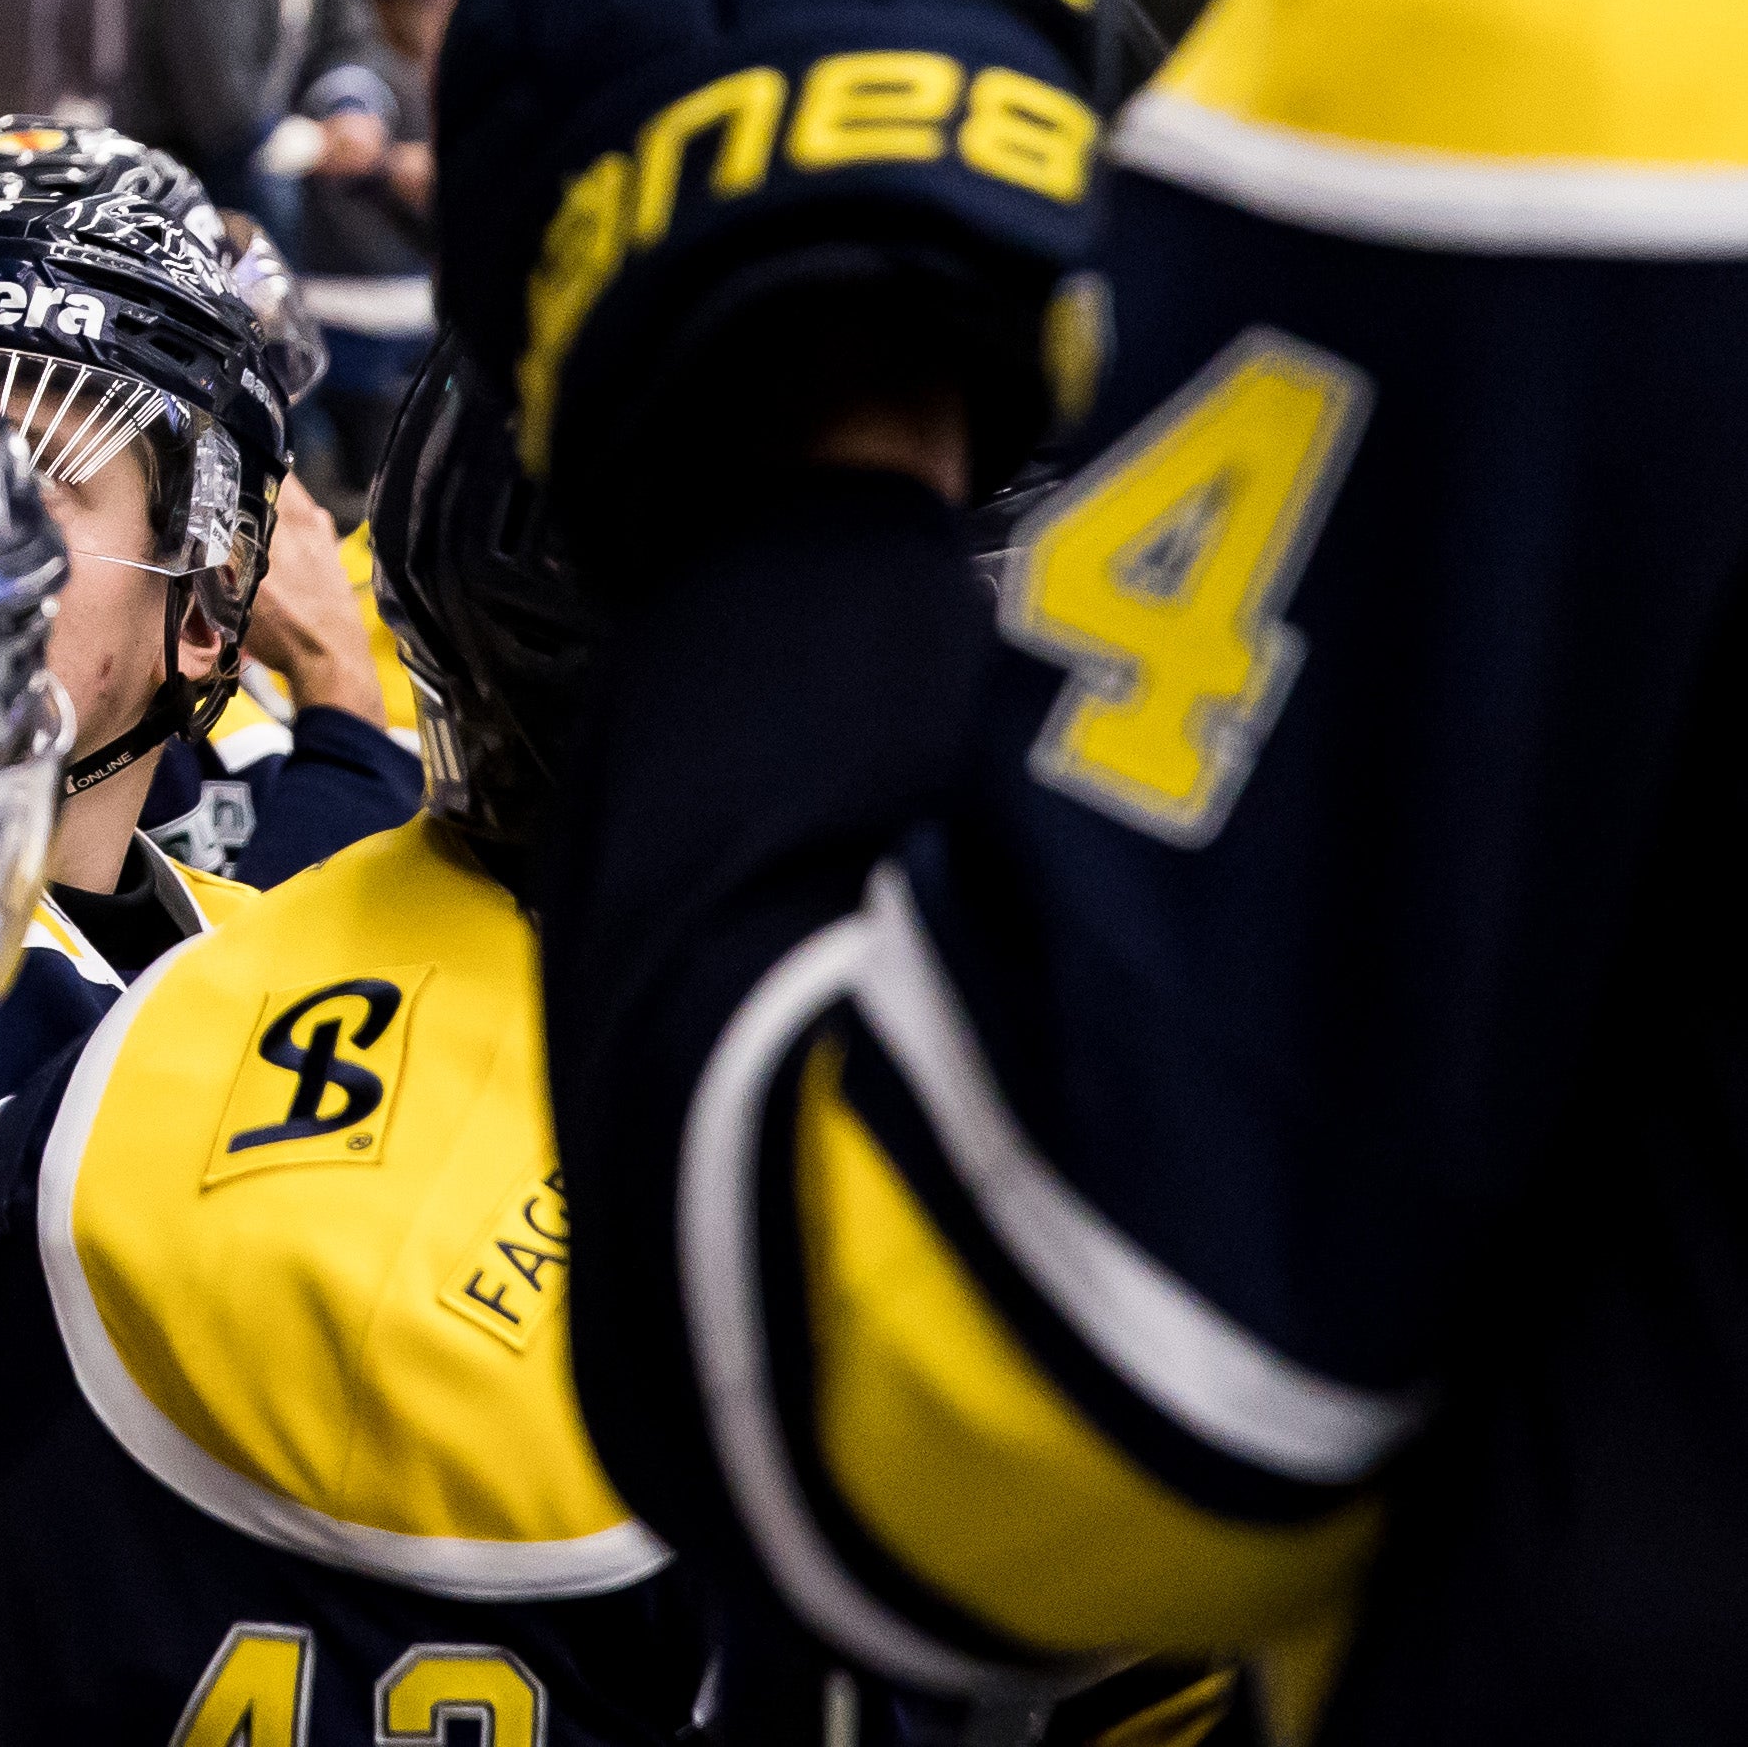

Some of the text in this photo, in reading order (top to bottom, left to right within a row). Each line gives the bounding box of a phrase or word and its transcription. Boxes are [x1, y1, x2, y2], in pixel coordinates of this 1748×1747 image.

[995, 320, 1377, 850] 4
[76, 750, 135, 790] ONLINE
[463, 1170, 571, 1325] FAG
